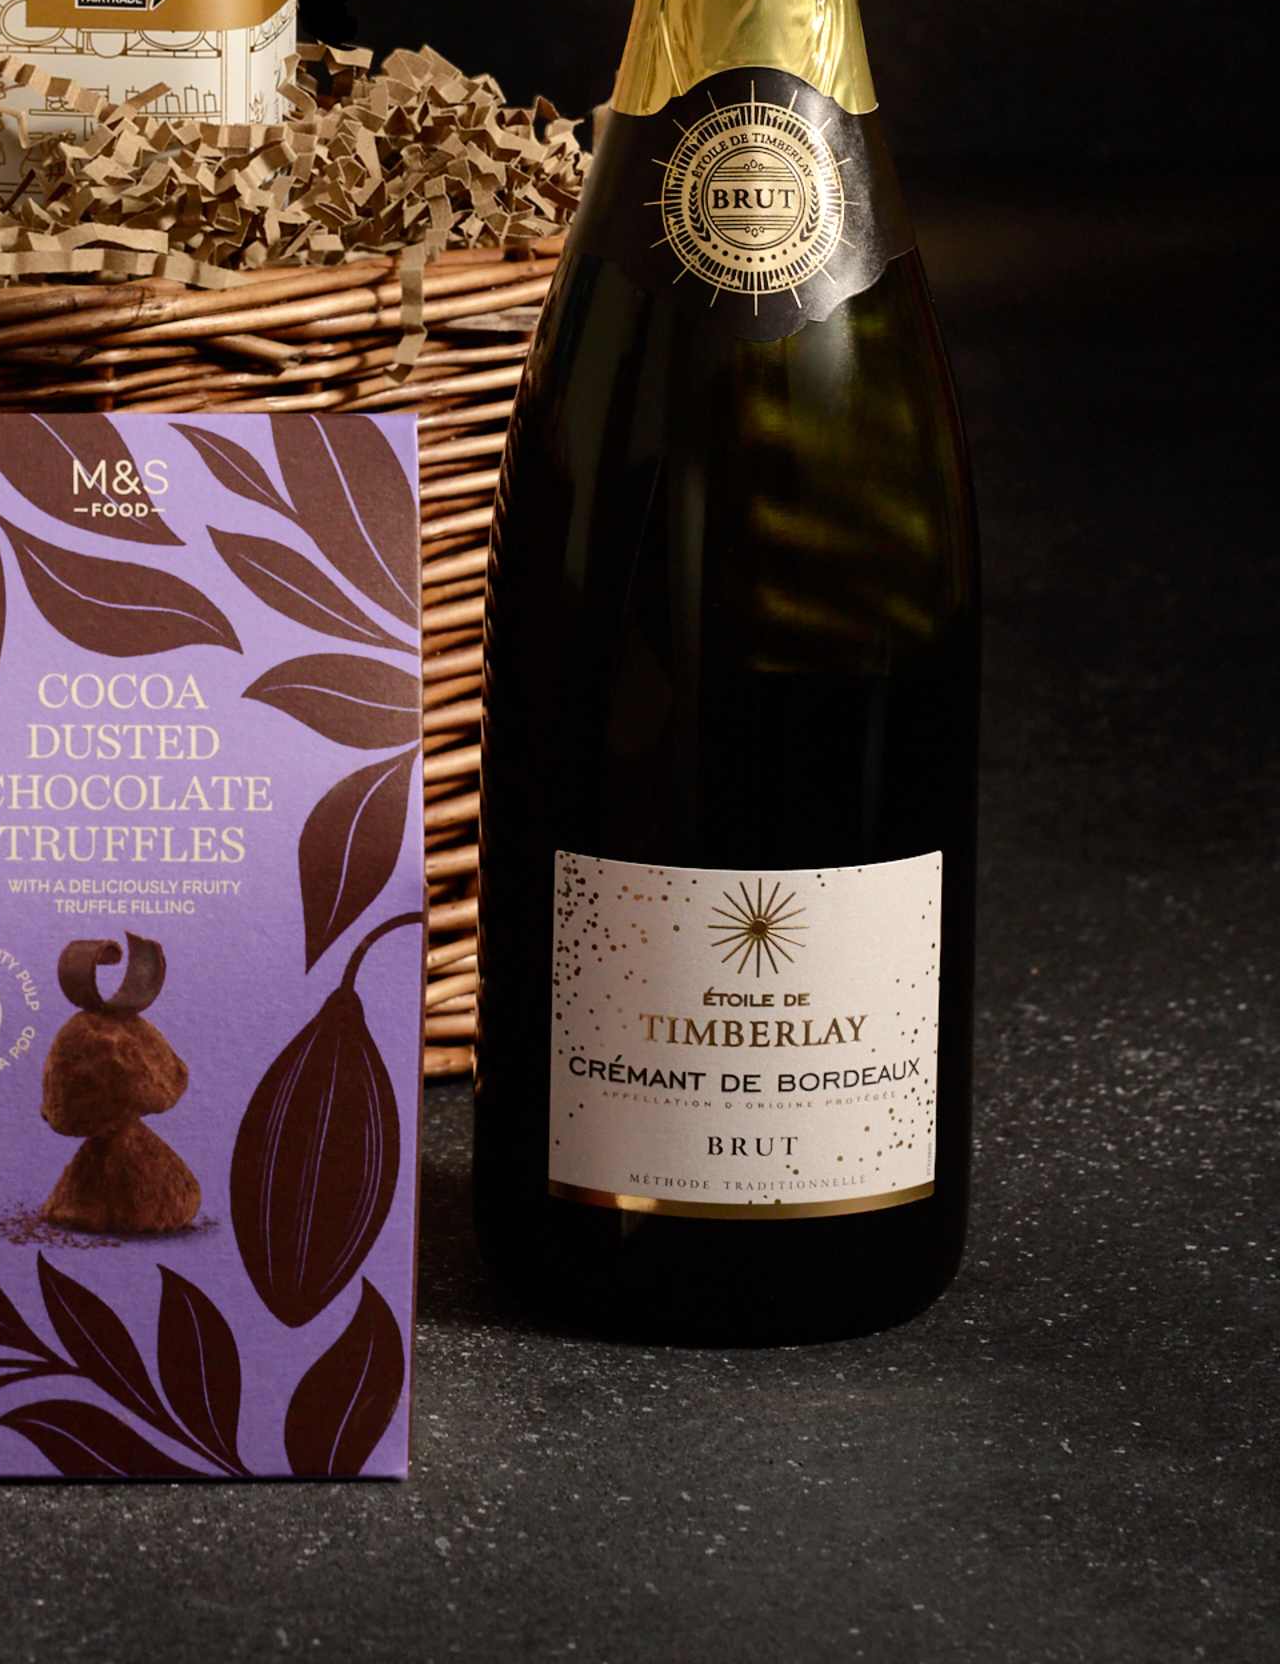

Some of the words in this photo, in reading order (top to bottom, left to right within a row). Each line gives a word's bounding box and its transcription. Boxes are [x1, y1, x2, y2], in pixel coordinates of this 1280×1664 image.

[730, 134, 749, 146] DE
[751, 132, 814, 178] TIMBERLAY
[712, 188, 796, 209] BRUT
[72, 459, 170, 496] M&S
[91, 502, 149, 518] FOOD
[37, 673, 209, 709] COCOA
[26, 724, 221, 761] DUSTED
[8, 879, 50, 894] WITH
[52, 880, 65, 894] A
[69, 879, 179, 895] DELICIOUSLY
[182, 880, 242, 895] FRUITY
[55, 899, 128, 914] TRUFFLE
[131, 899, 196, 914] FILLING
[16, 969, 40, 1011] PULP
[703, 987, 776, 1008] ÉTOILE
[783, 992, 811, 1007] DE
[9, 1026, 36, 1059] POD
[639, 1013, 869, 1048] TIMBERLAY
[568, 1055, 707, 1092] CRÉMANT
[721, 1074, 762, 1093] DE
[777, 1057, 921, 1093] BORDEAUX
[601, 1090, 712, 1108] APPELLATION
[707, 1136, 799, 1157] BRUT
[629, 1173, 711, 1190] MÉTHODE
[723, 1174, 866, 1191] TRADITIONNELLE
